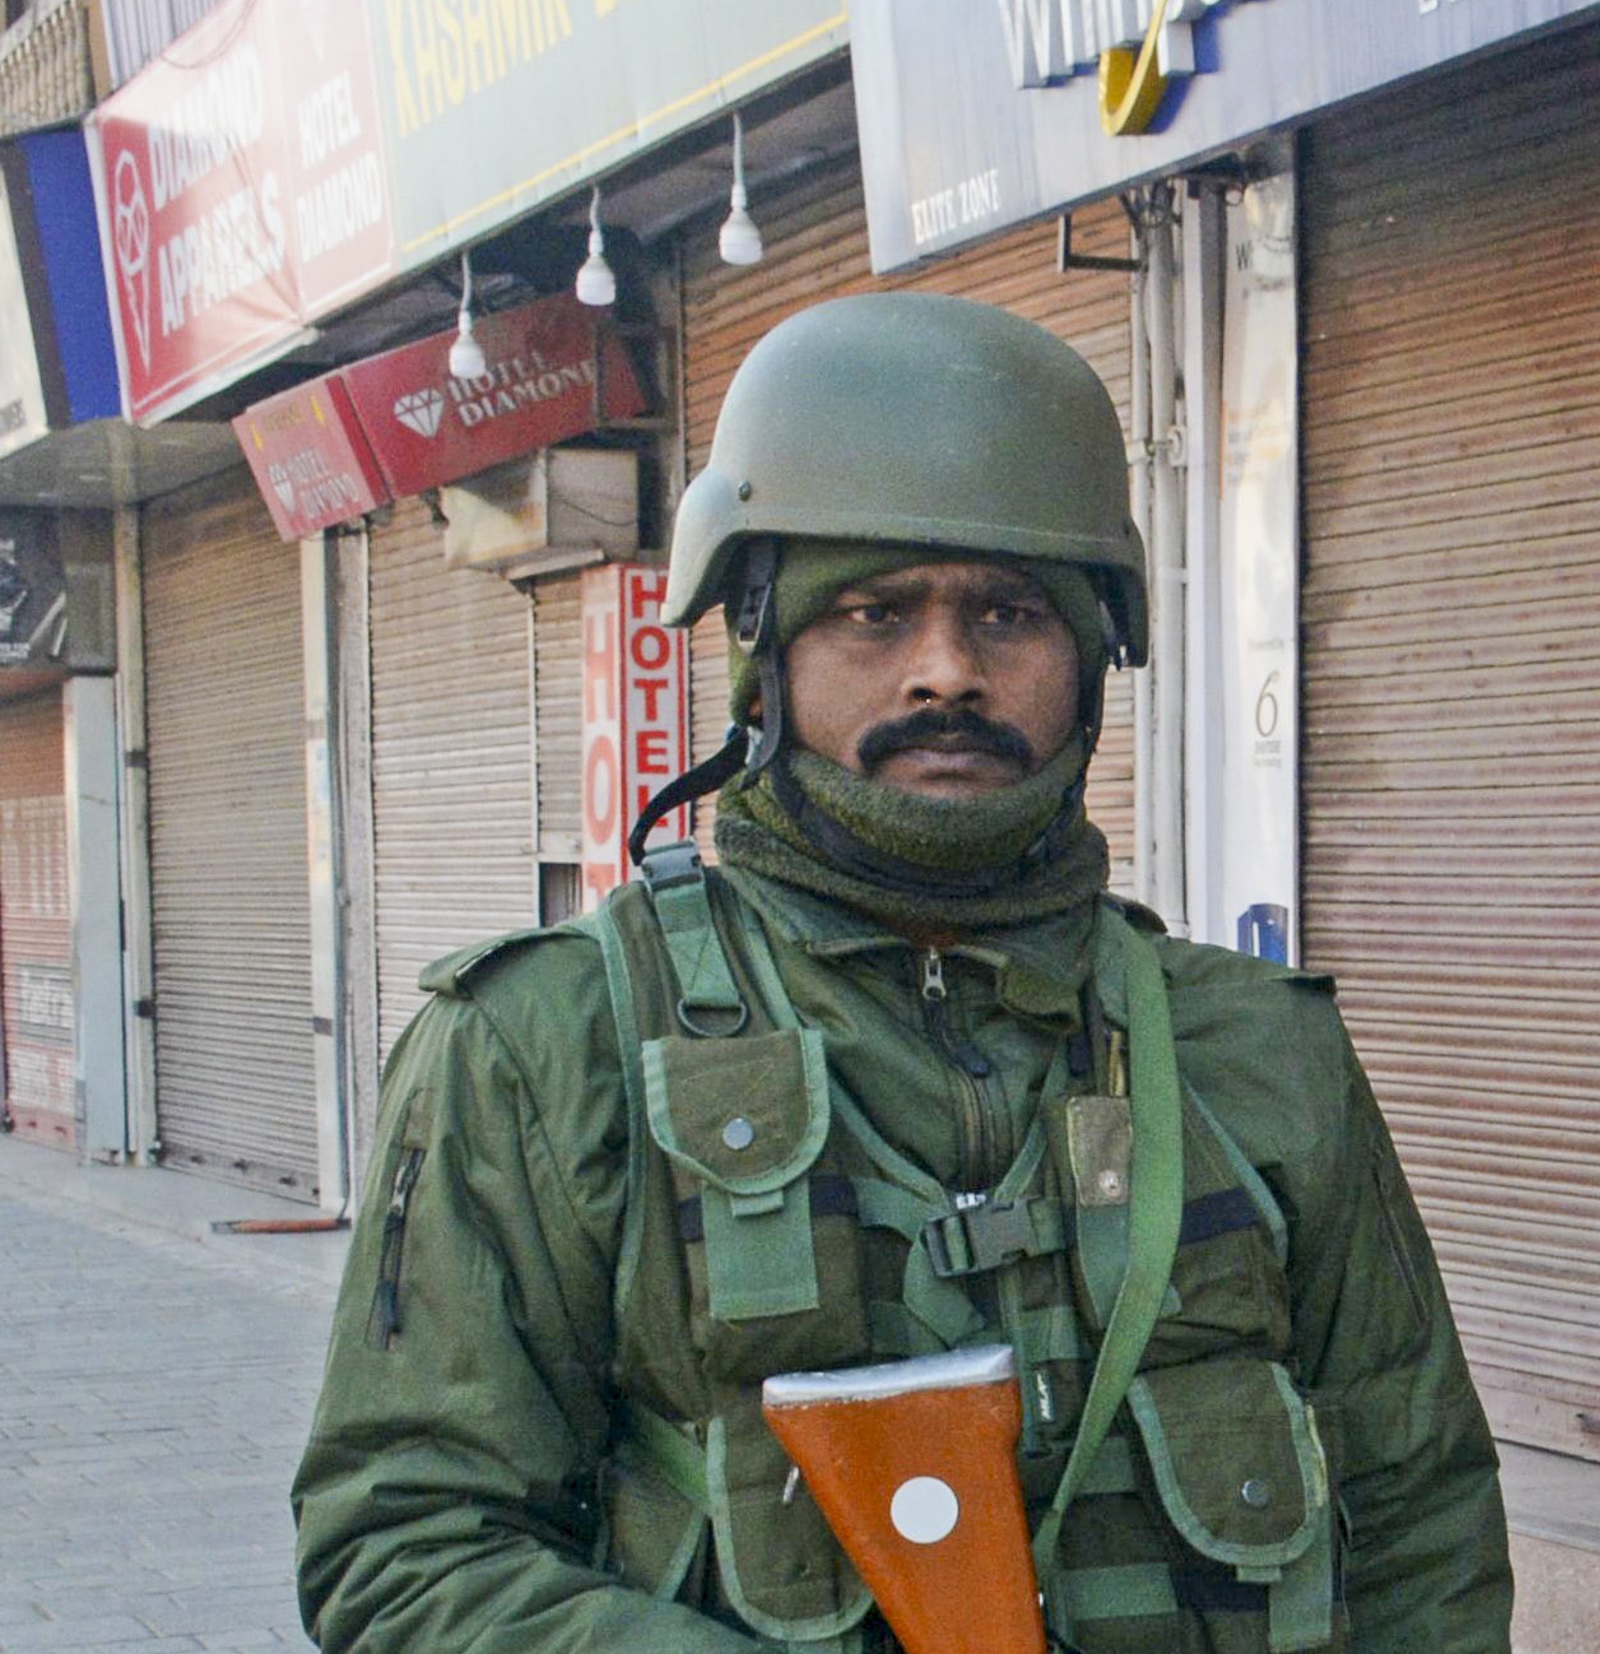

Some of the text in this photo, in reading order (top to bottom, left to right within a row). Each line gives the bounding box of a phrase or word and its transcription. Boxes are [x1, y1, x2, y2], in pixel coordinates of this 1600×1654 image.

[149, 42, 264, 213] DIAMOND
[299, 69, 362, 171] HOTEL
[157, 169, 286, 337] APPARELS
[297, 150, 383, 265] DIAMOND
[911, 168, 999, 245] ELITE ZONE
[630, 574, 671, 829] HOTEL
